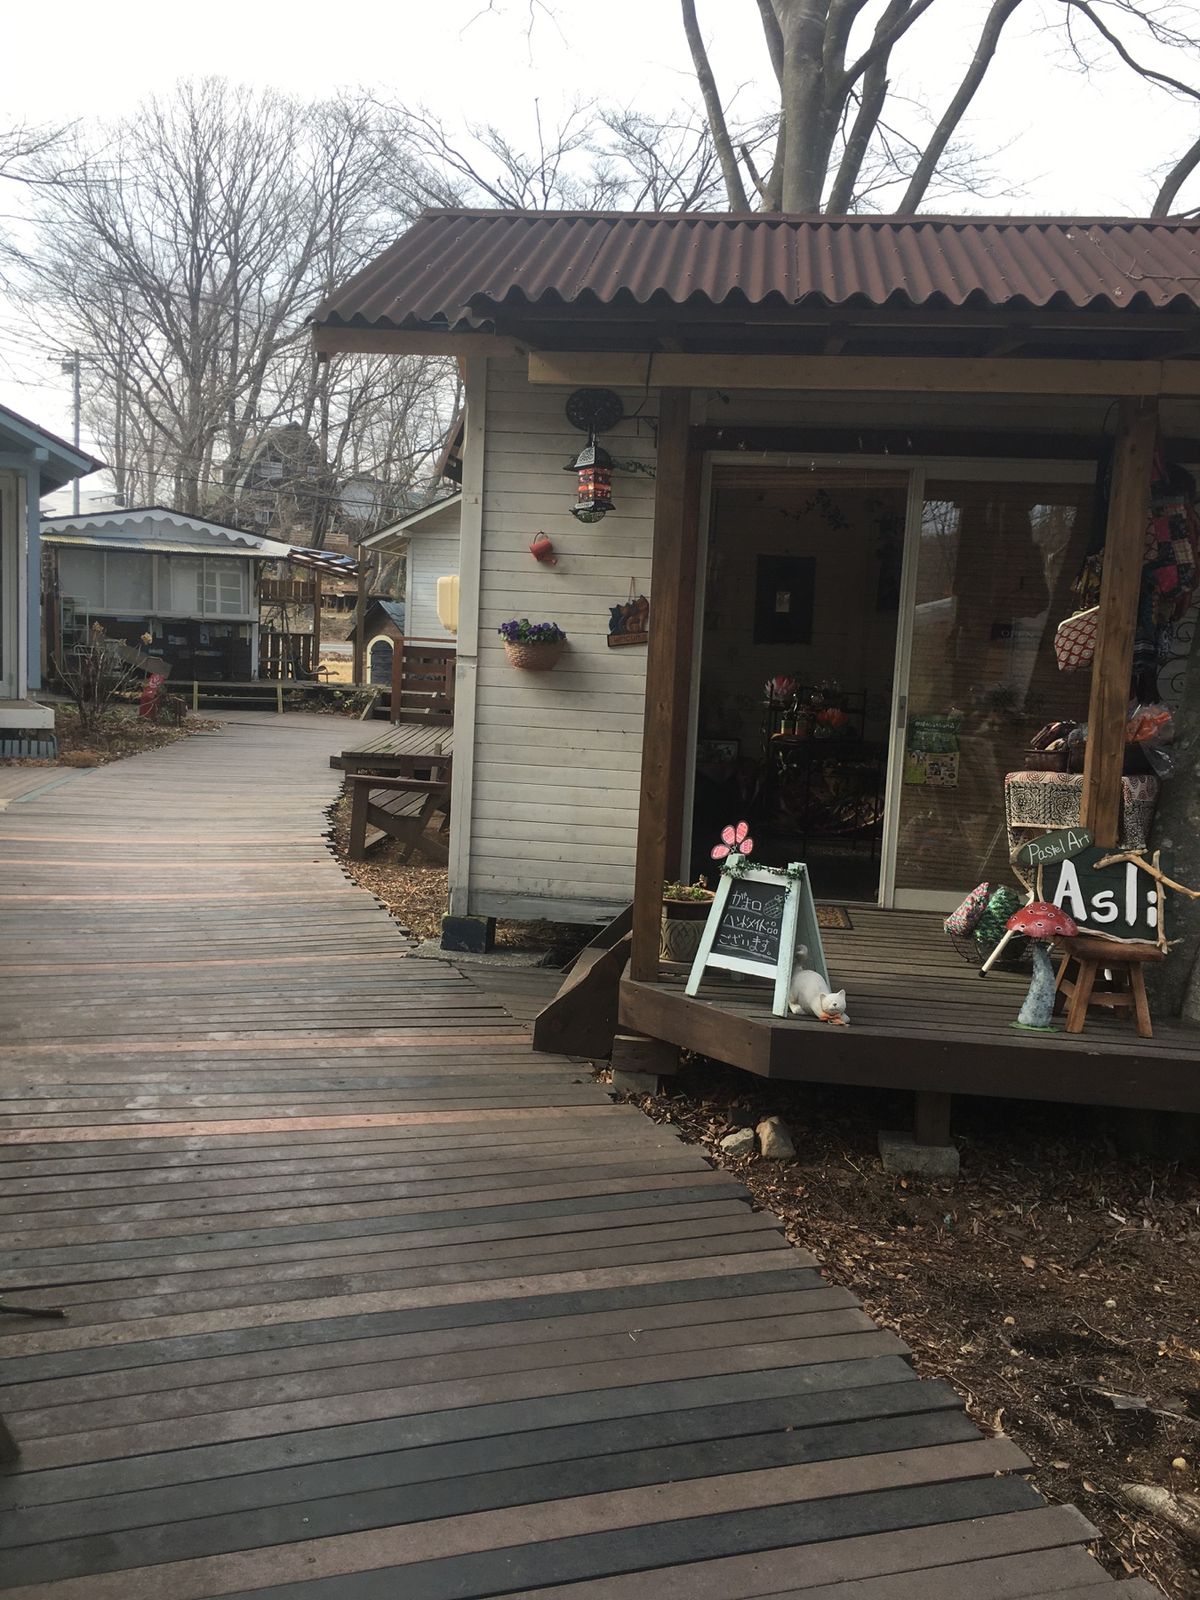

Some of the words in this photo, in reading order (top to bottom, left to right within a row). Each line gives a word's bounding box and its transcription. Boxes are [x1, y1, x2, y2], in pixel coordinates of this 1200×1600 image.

[1027, 838, 1065, 865] Pastel
[1068, 830, 1090, 851] Art
[731, 890, 762, 911] がま口
[1053, 858, 1158, 928] Asli
